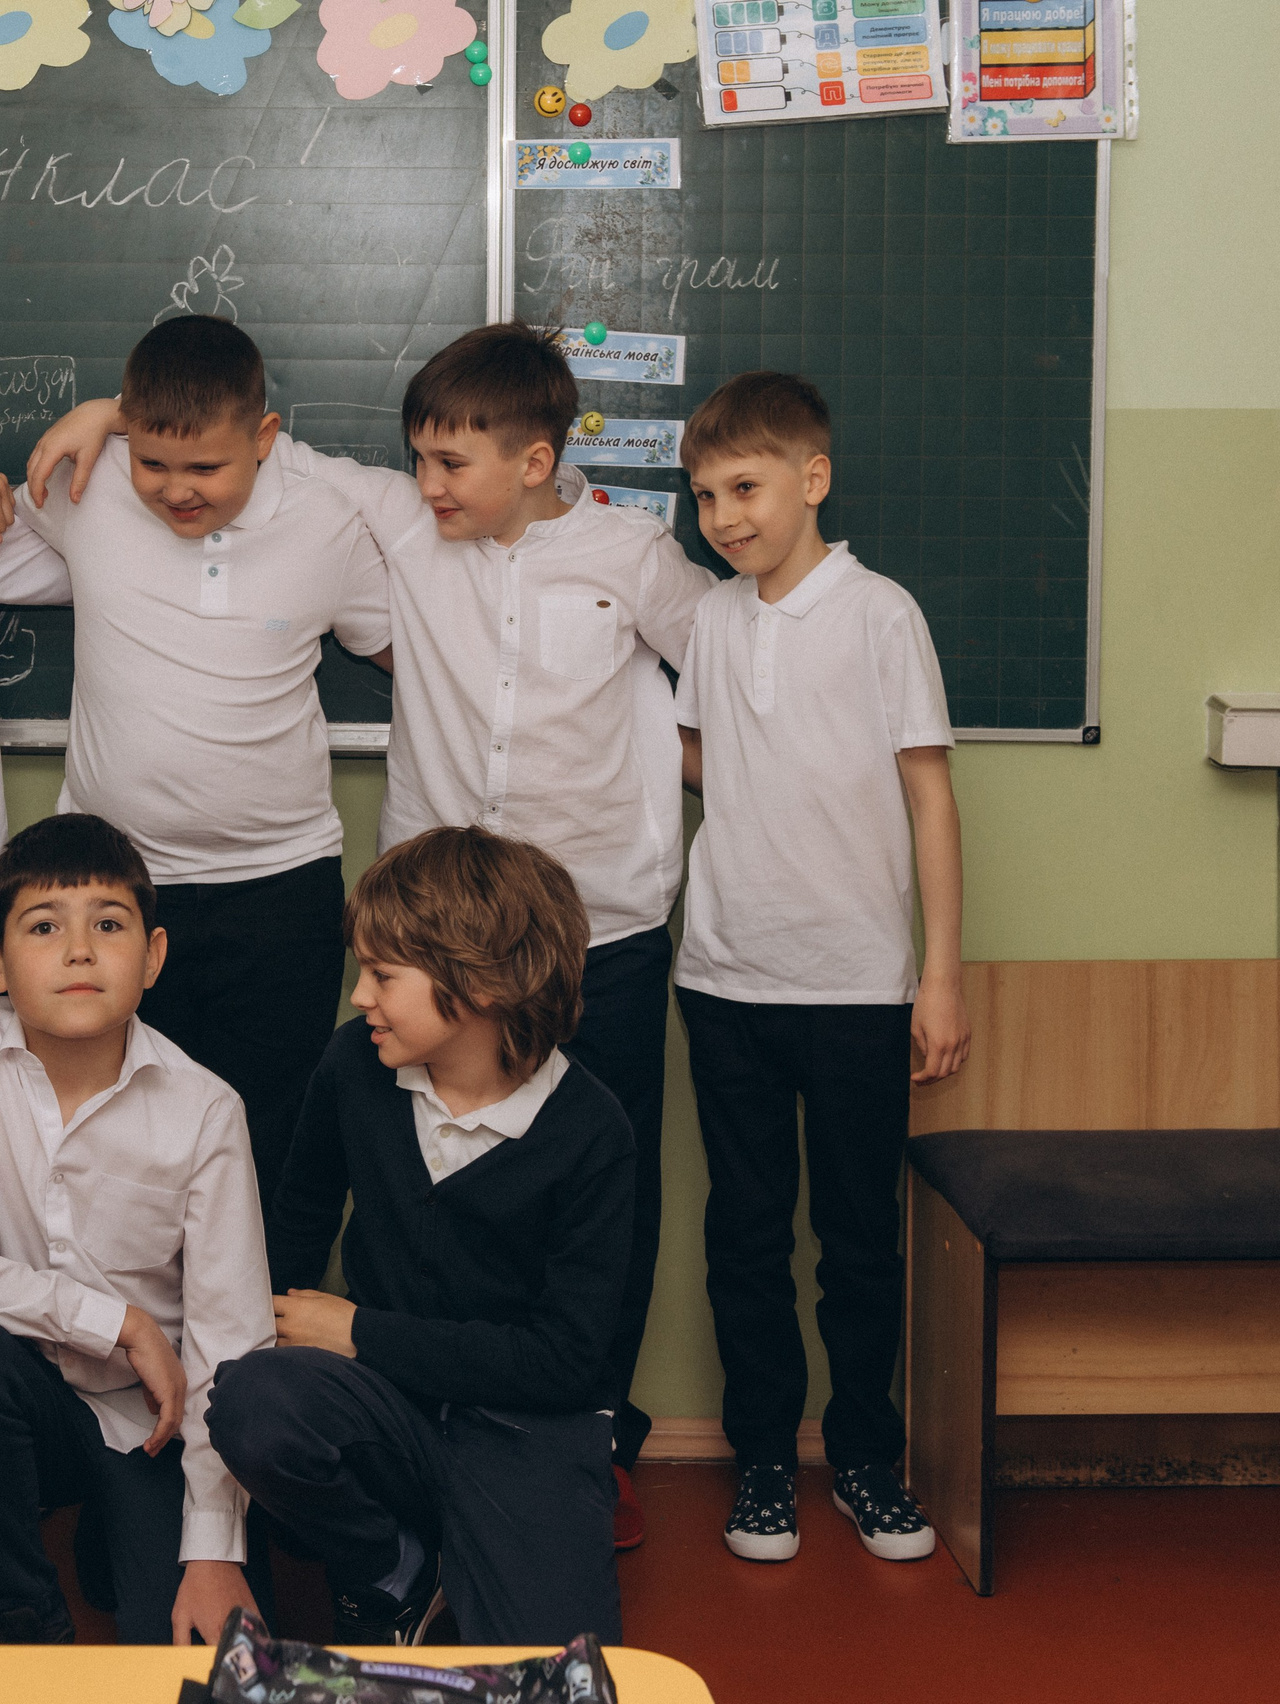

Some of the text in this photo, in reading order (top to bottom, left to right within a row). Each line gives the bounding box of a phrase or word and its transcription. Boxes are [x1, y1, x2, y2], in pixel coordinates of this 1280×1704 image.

[982, 6, 1084, 24] Я працюю добре!
[982, 73, 1085, 89] Мені потрібна допомога!
[536, 157, 546, 170] Я
[623, 156, 652, 170] світ
[624, 351, 659, 362] мова
[566, 434, 658, 448] глійська мова
